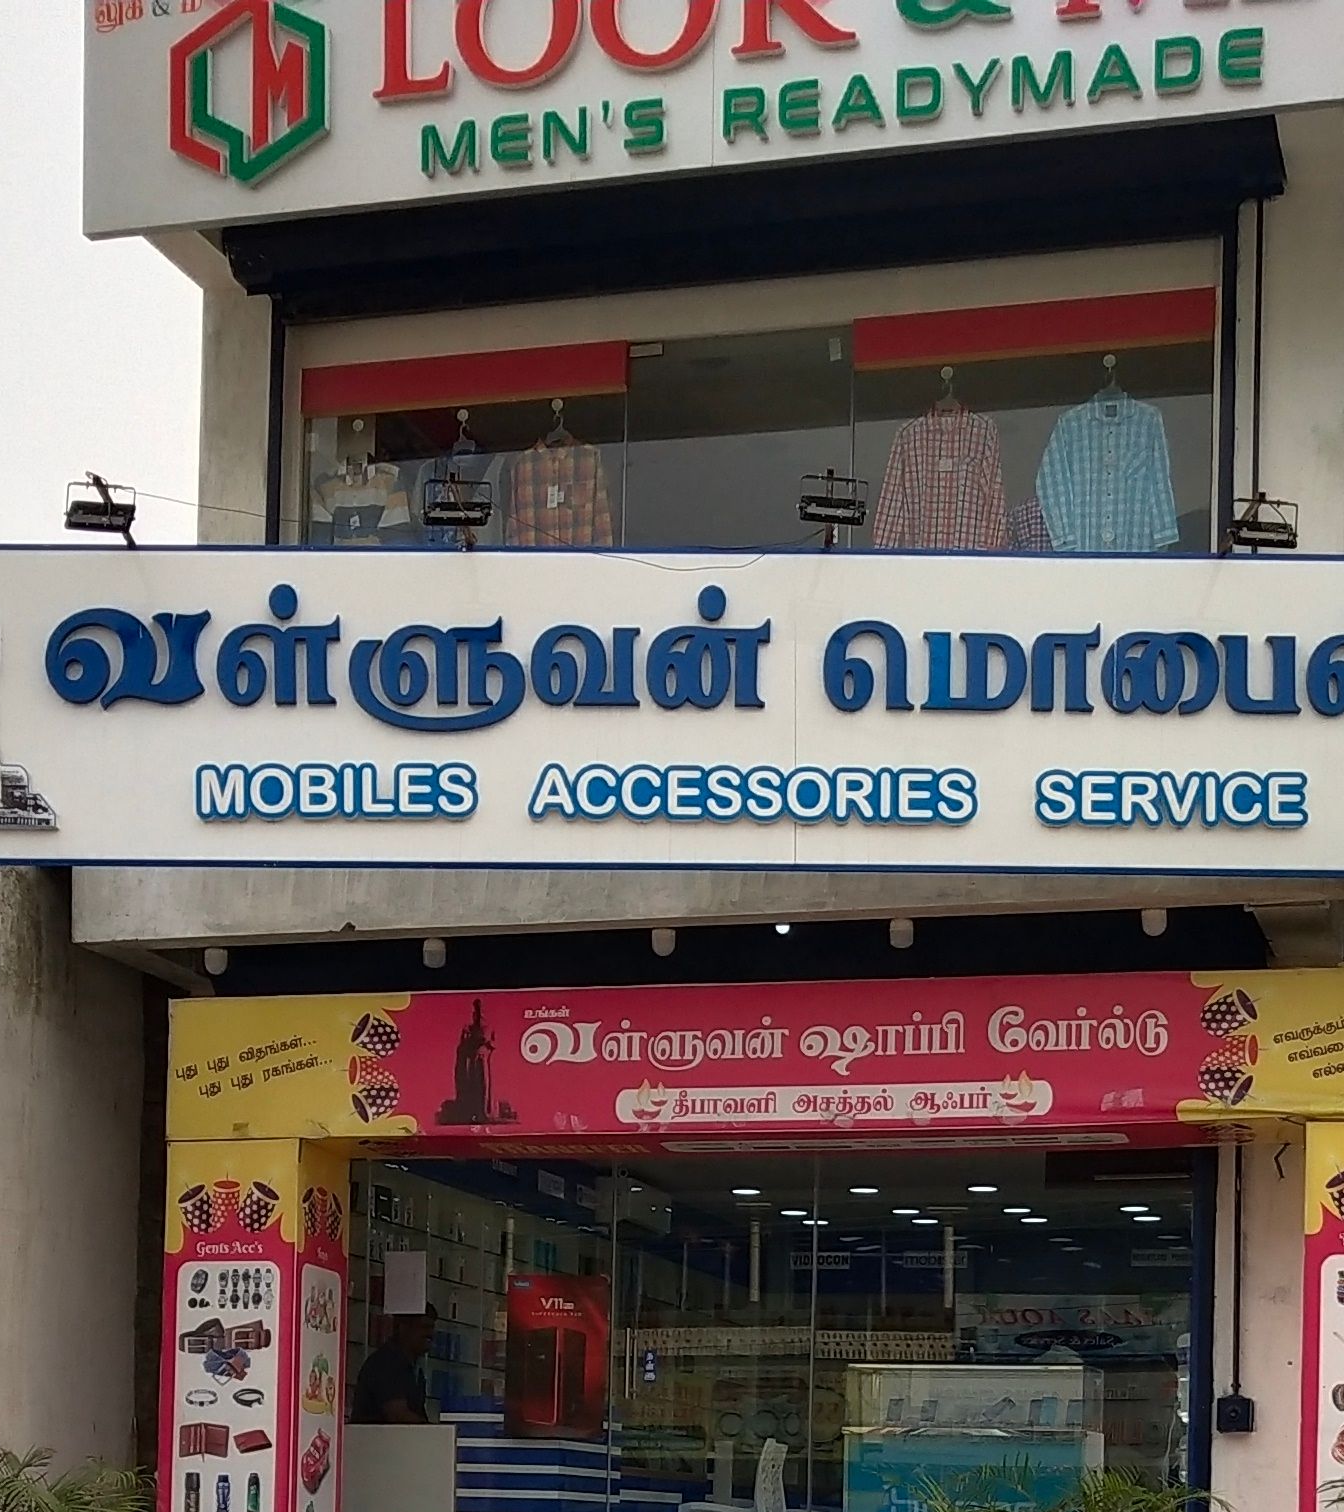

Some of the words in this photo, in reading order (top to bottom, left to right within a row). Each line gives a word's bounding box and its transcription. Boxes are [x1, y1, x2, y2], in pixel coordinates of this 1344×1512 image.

[421, 97, 666, 178] MEN'S
[721, 27, 1265, 143] READYMADE
[44, 583, 772, 733] வள்ளுவன்
[196, 763, 480, 822] MOBILES
[527, 763, 979, 826] ACCESSORIES
[1035, 768, 1310, 829] SERVICE
[523, 1004, 571, 1019] உங்கள்
[520, 1016, 790, 1072] வள்ளுவன்
[799, 1010, 966, 1077] ஷாப்பி
[987, 1004, 1169, 1057] வேர்ல்டு
[175, 1063, 198, 1081] புது
[207, 1056, 230, 1073] புது
[198, 1080, 222, 1098] புது
[230, 1072, 253, 1091] புது
[671, 1090, 778, 1120] தீபாவளி
[791, 1087, 895, 1117] அசத்தல்
[908, 1085, 993, 1115] ஆஃபர்
[196, 1241, 230, 1257] Gents
